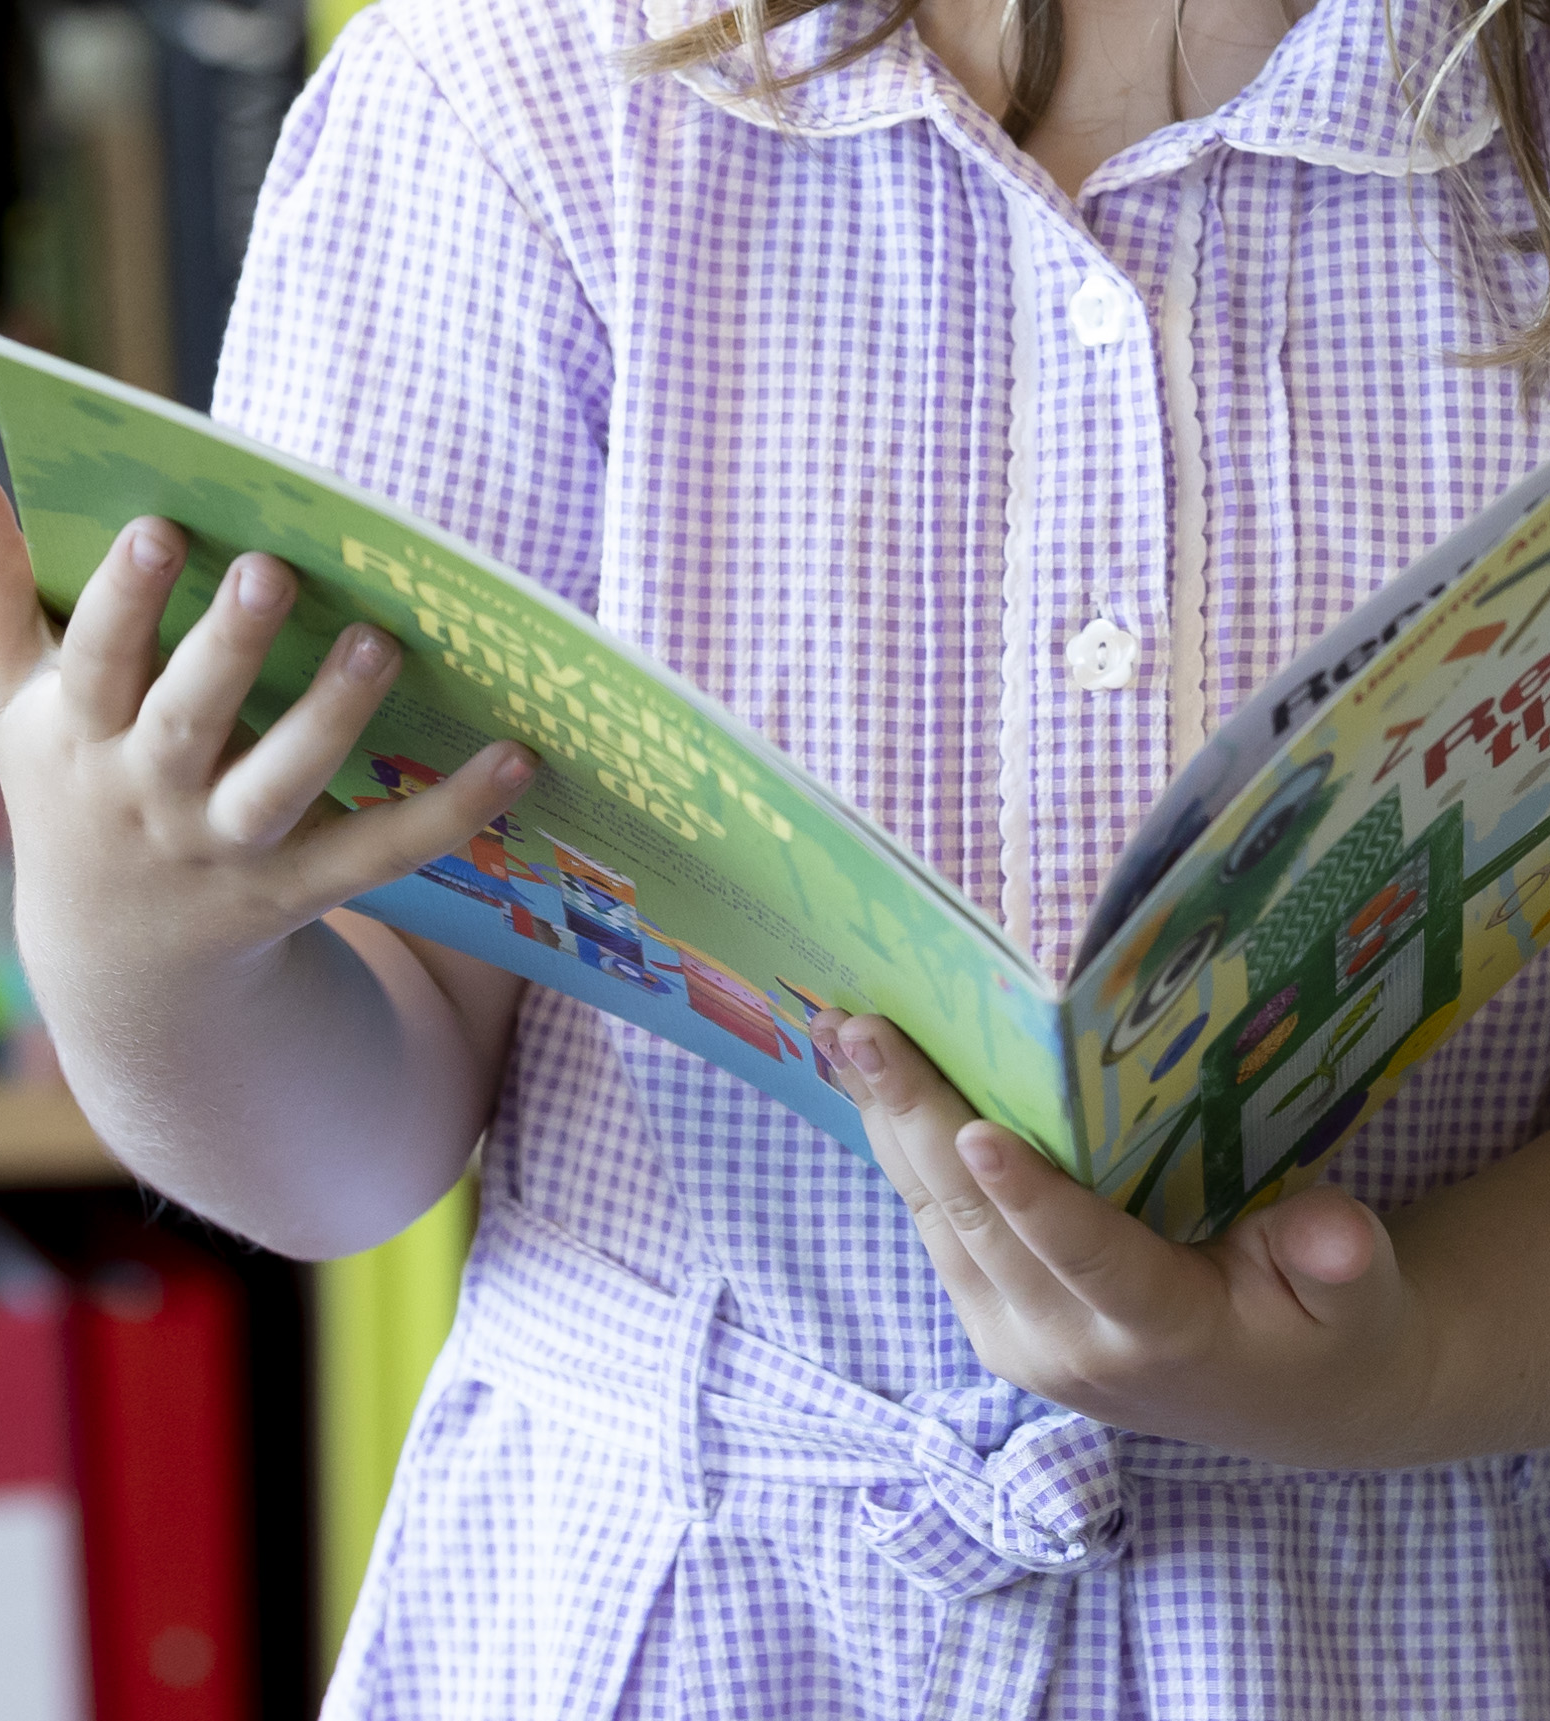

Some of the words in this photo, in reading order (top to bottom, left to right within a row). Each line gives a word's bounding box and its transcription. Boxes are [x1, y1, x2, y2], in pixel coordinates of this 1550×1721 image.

[341, 535, 793, 842] Recycling
[412, 606, 694, 790] things
[442, 650, 494, 687] to
[507, 690, 727, 840] make
[491, 706, 576, 760] and
[597, 769, 698, 841] do
